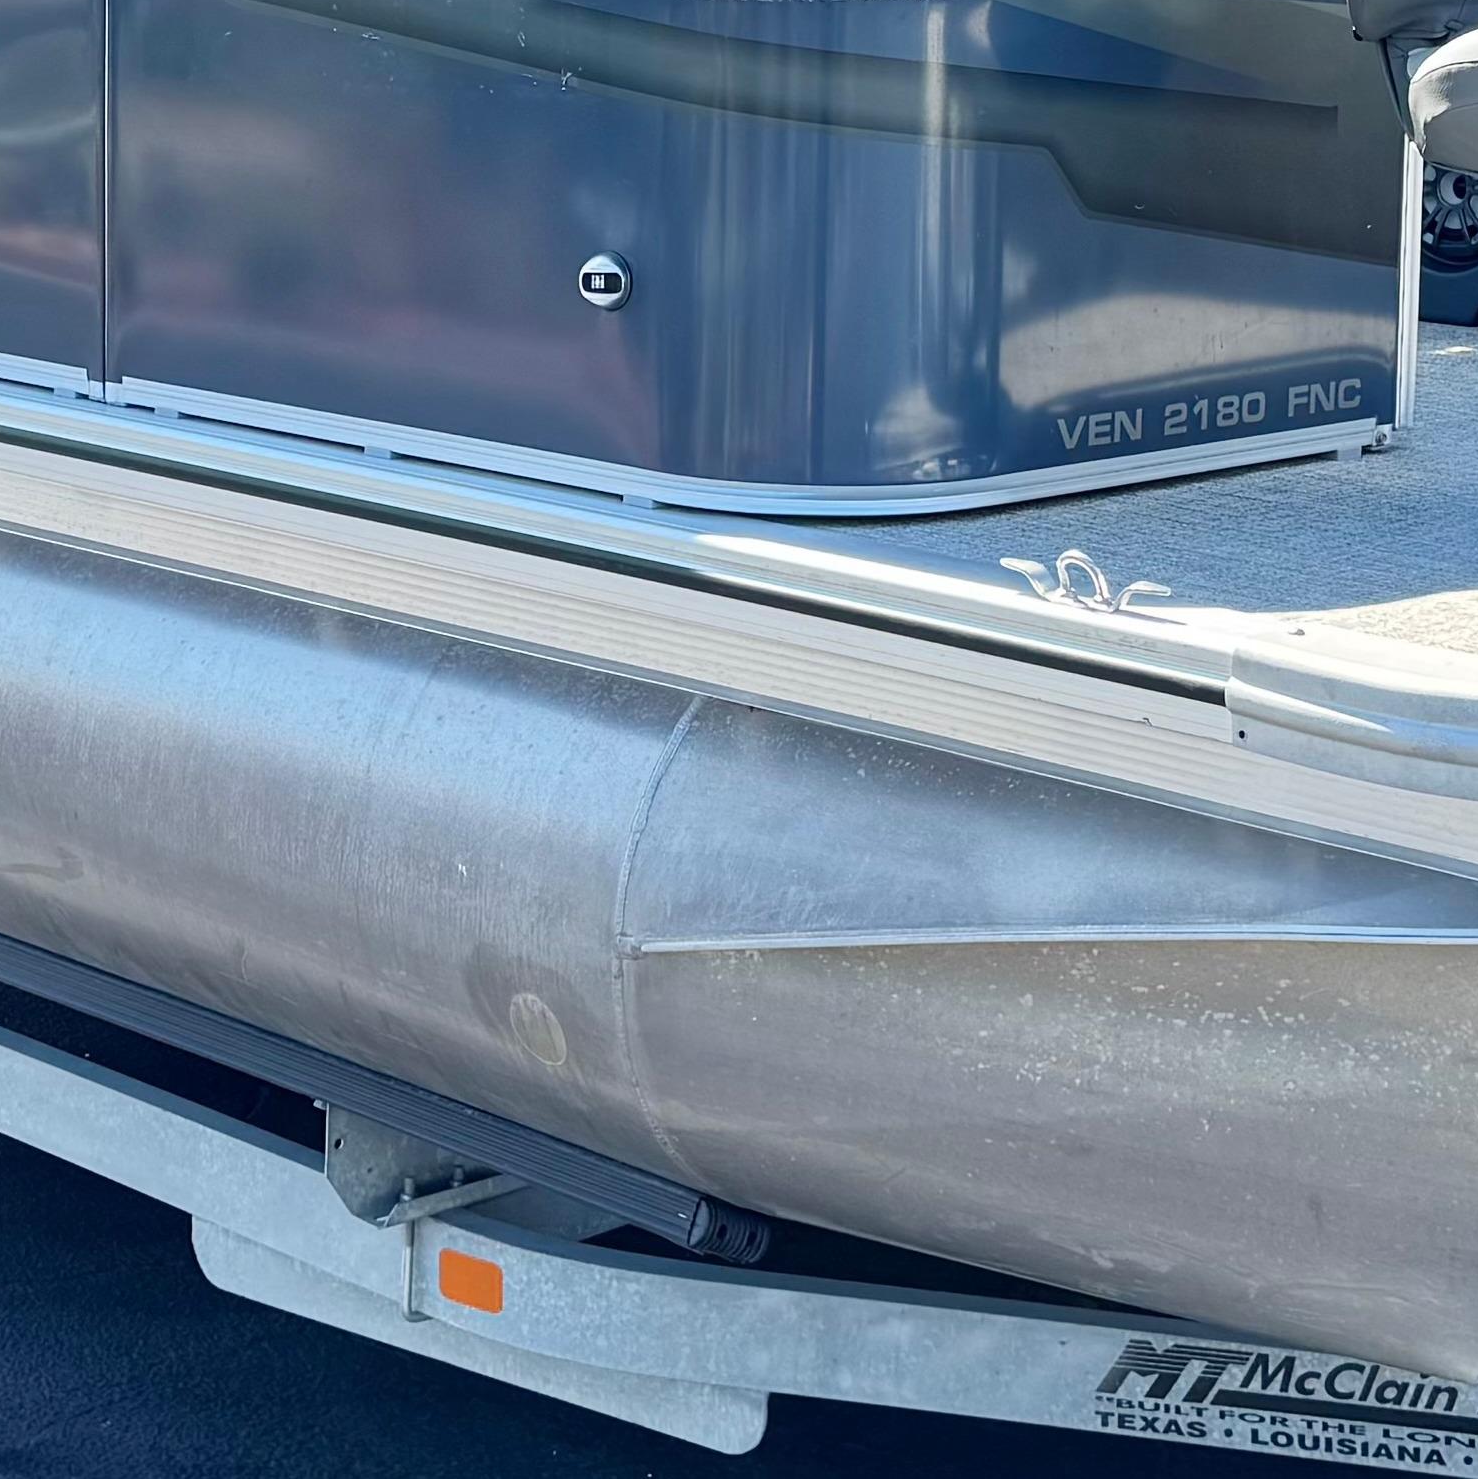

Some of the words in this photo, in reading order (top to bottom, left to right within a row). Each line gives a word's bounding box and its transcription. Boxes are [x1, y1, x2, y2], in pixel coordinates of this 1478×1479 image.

[1057, 409, 1143, 449] VEN
[1164, 391, 1266, 435] 2180
[1288, 379, 1362, 417] FNC
[1239, 1353, 1458, 1412] McClain
[1094, 1411, 1207, 1438] TEXAS
[1251, 1428, 1446, 1466] LOUISIANA
[1219, 1409, 1289, 1427] FOR
[1301, 1418, 1367, 1436] THE
